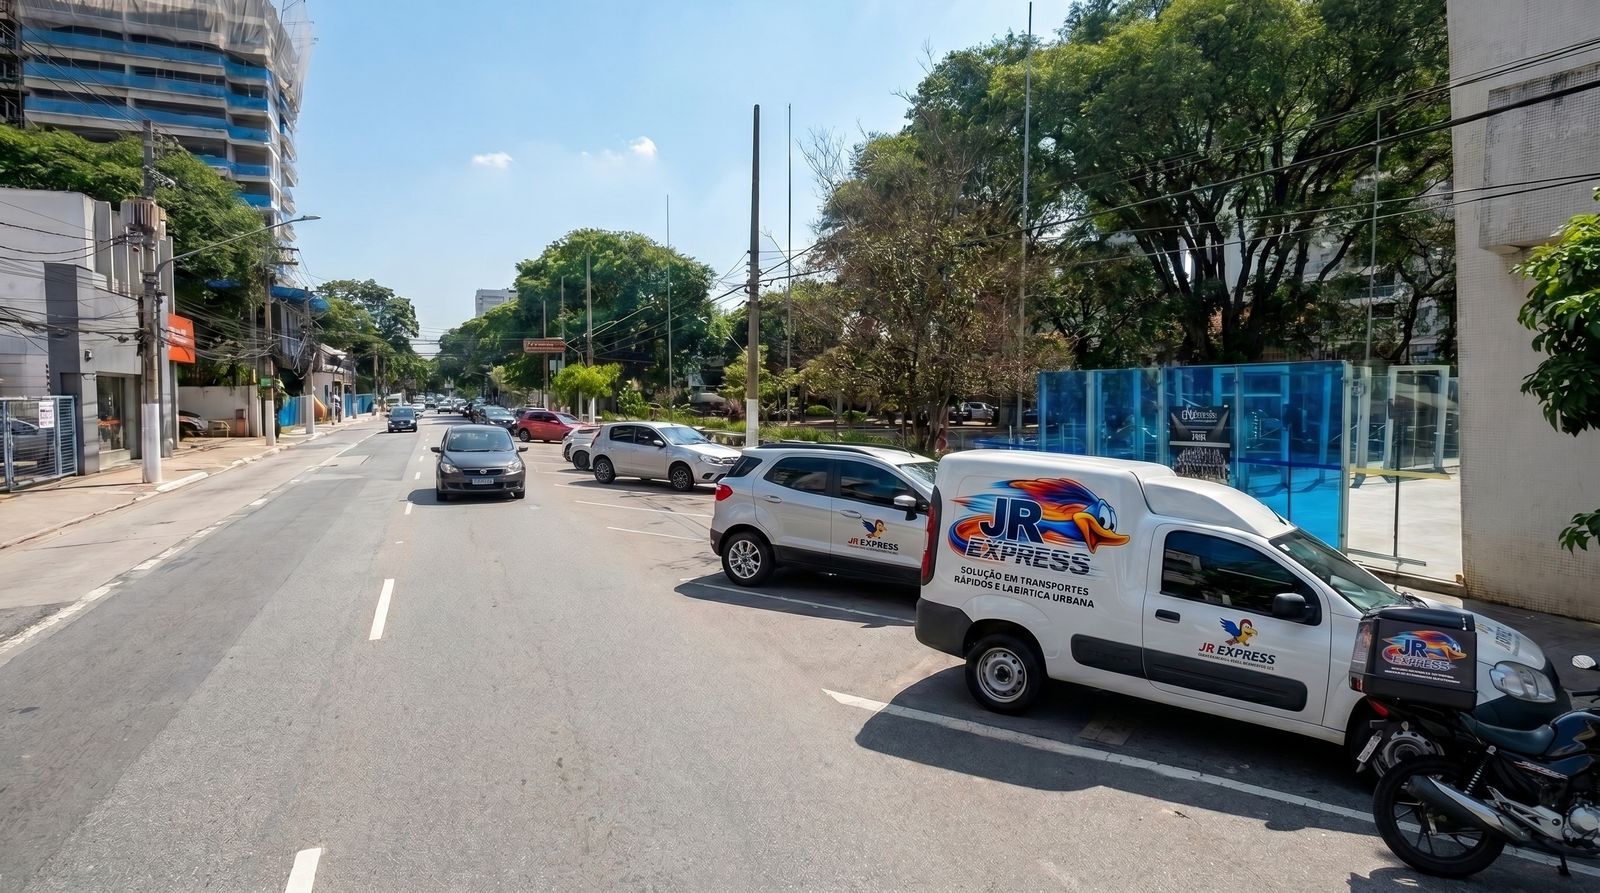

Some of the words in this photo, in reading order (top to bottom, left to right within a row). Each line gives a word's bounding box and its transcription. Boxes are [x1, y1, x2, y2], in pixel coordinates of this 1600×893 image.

[979, 496, 1044, 543] JR
[847, 537, 859, 545] JR
[860, 538, 899, 551] EXPRESS
[965, 536, 1091, 575] EXPRESS
[954, 575, 993, 589] RÁPIDOS
[995, 582, 1001, 590] E
[1052, 593, 1095, 608] URBANA
[960, 566, 1002, 580] SOLUÇÃO
[1004, 573, 1018, 583] EM
[1020, 576, 1089, 596] TRANSPORTES
[1198, 642, 1215, 653] JR
[1217, 645, 1276, 665] EXPRESS
[1398, 639, 1428, 658] JR
[1391, 655, 1451, 671] EXPRESS
